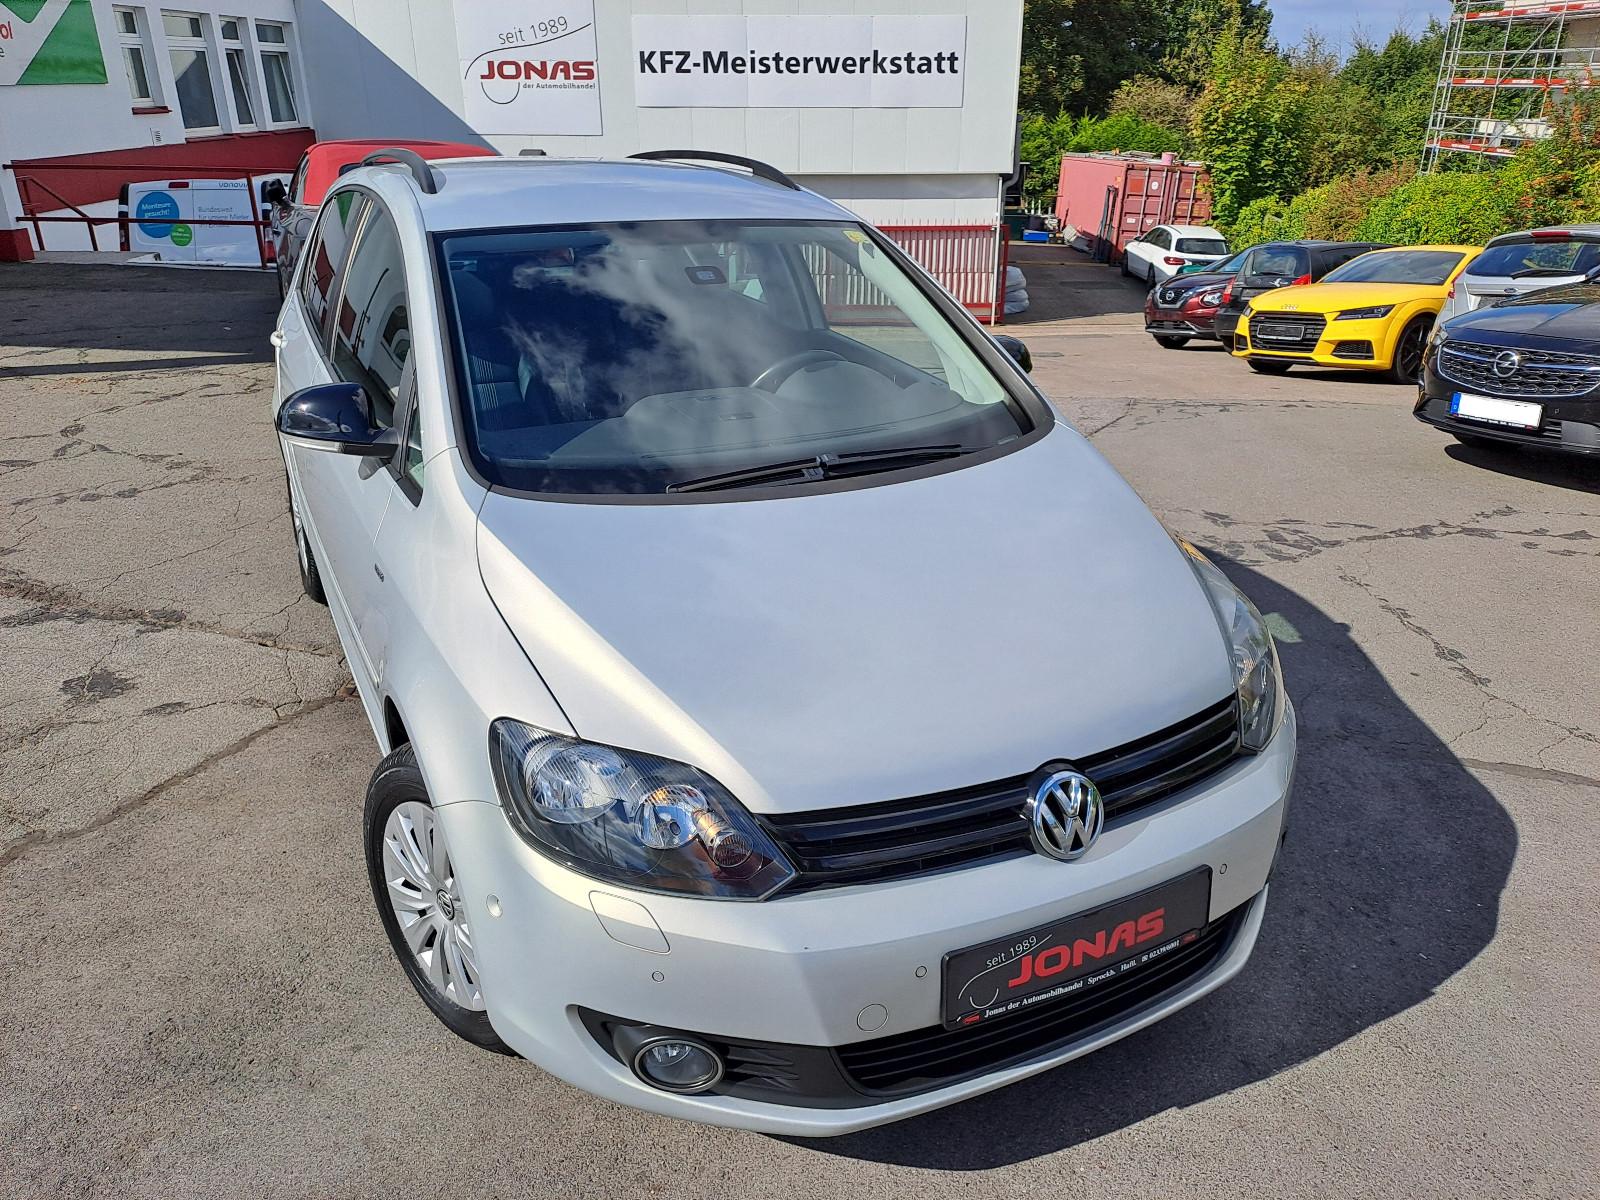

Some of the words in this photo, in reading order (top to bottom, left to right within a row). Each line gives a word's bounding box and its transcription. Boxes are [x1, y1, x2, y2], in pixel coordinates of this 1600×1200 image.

[498, 27, 525, 45] seit
[530, 16, 568, 39] 1989
[480, 60, 595, 80] JONAS
[639, 50, 959, 74] KFZ-Meisterwerkstatt
[536, 82, 596, 90] Automobilhandel
[986, 952, 1006, 968] seit
[1009, 935, 1037, 957] 1989
[1008, 907, 1165, 989] JONAS
[984, 1006, 1007, 1018] Jonas
[1007, 1001, 1021, 1010] der
[1021, 980, 1083, 1006] Automobilhandel
